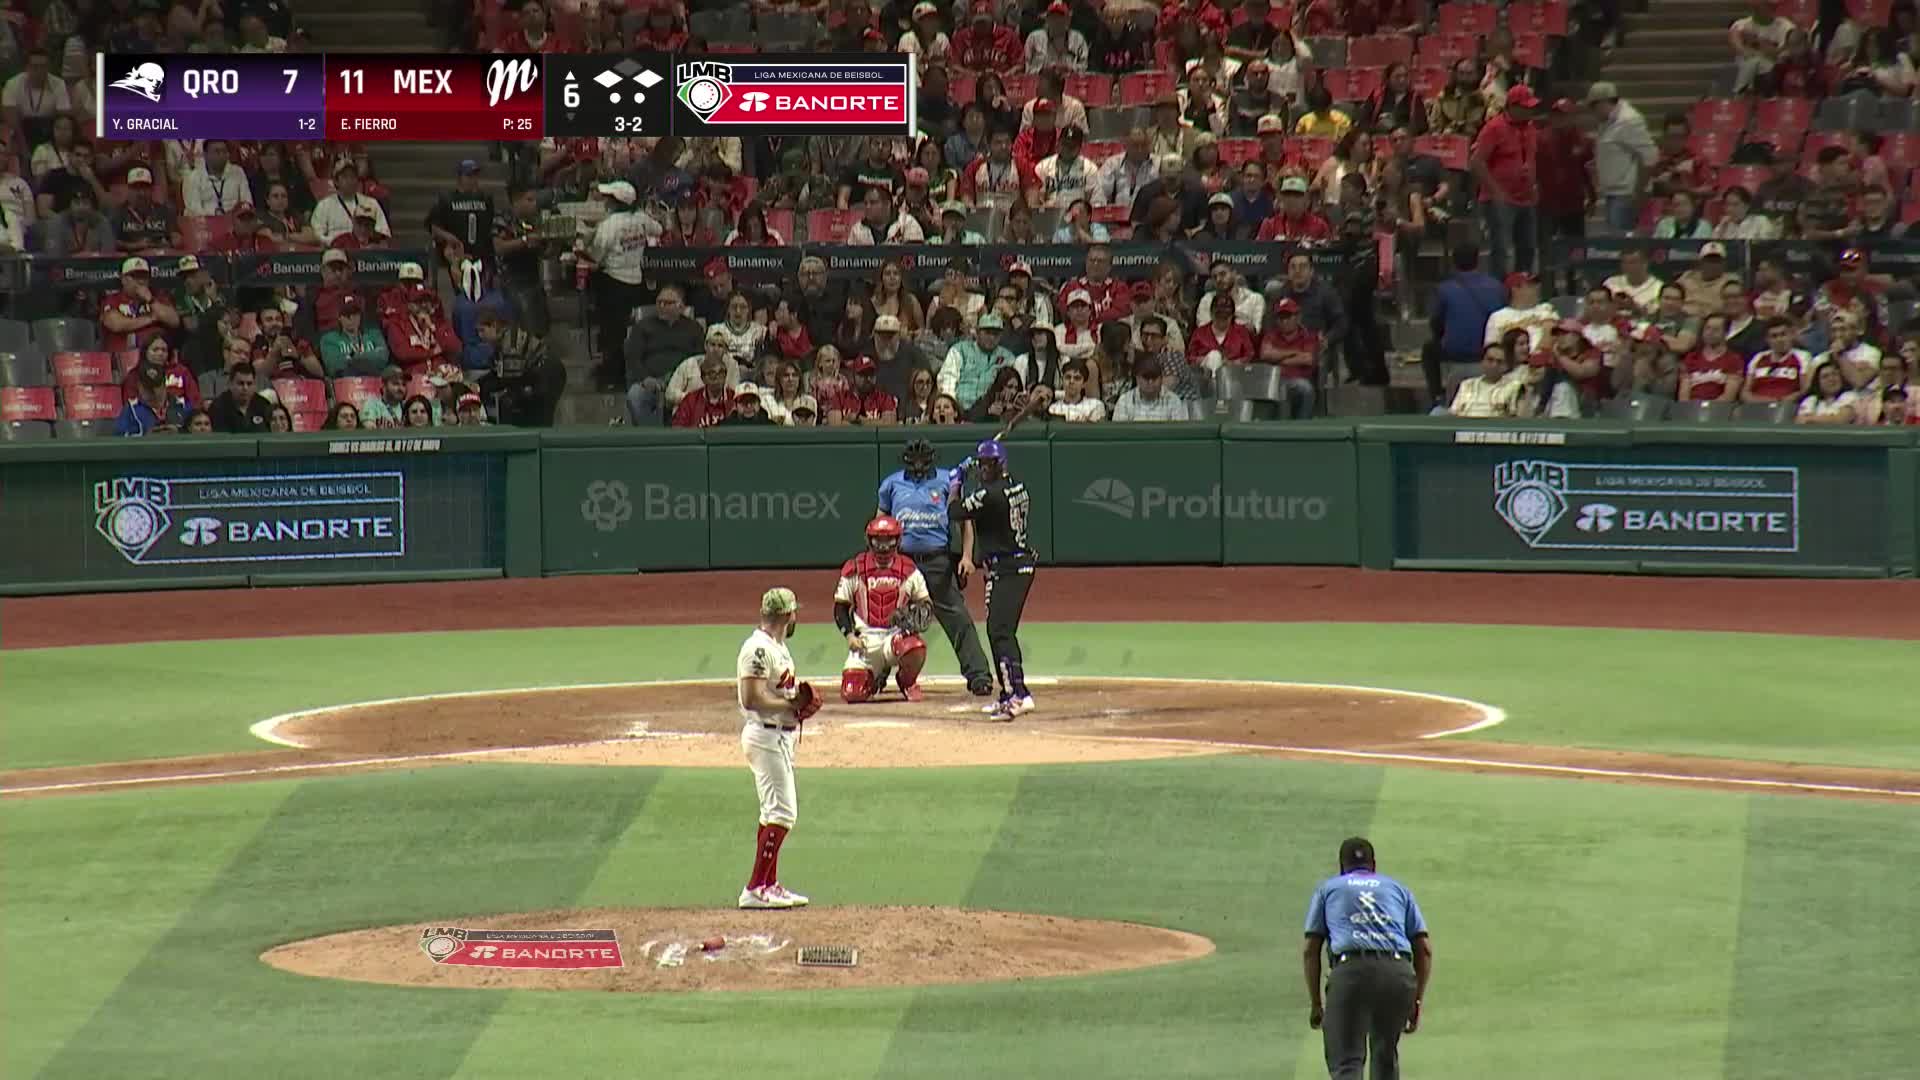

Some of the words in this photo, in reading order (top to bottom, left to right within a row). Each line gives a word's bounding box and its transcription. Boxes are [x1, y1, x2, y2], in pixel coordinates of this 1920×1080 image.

[357, 260, 400, 272] Banam
[728, 256, 784, 268] Banamex
[917, 255, 973, 267] Banax
[1016, 254, 1073, 266] Banamex
[1112, 255, 1160, 266] anamex
[273, 263, 320, 274] Baname
[644, 486, 841, 519] Banamex
[1141, 483, 1328, 520] Profuturo
[1624, 510, 1788, 532] BANORTE
[228, 518, 393, 542] BANORTE
[423, 928, 468, 940] LMB
[502, 949, 615, 958] BANORTE
